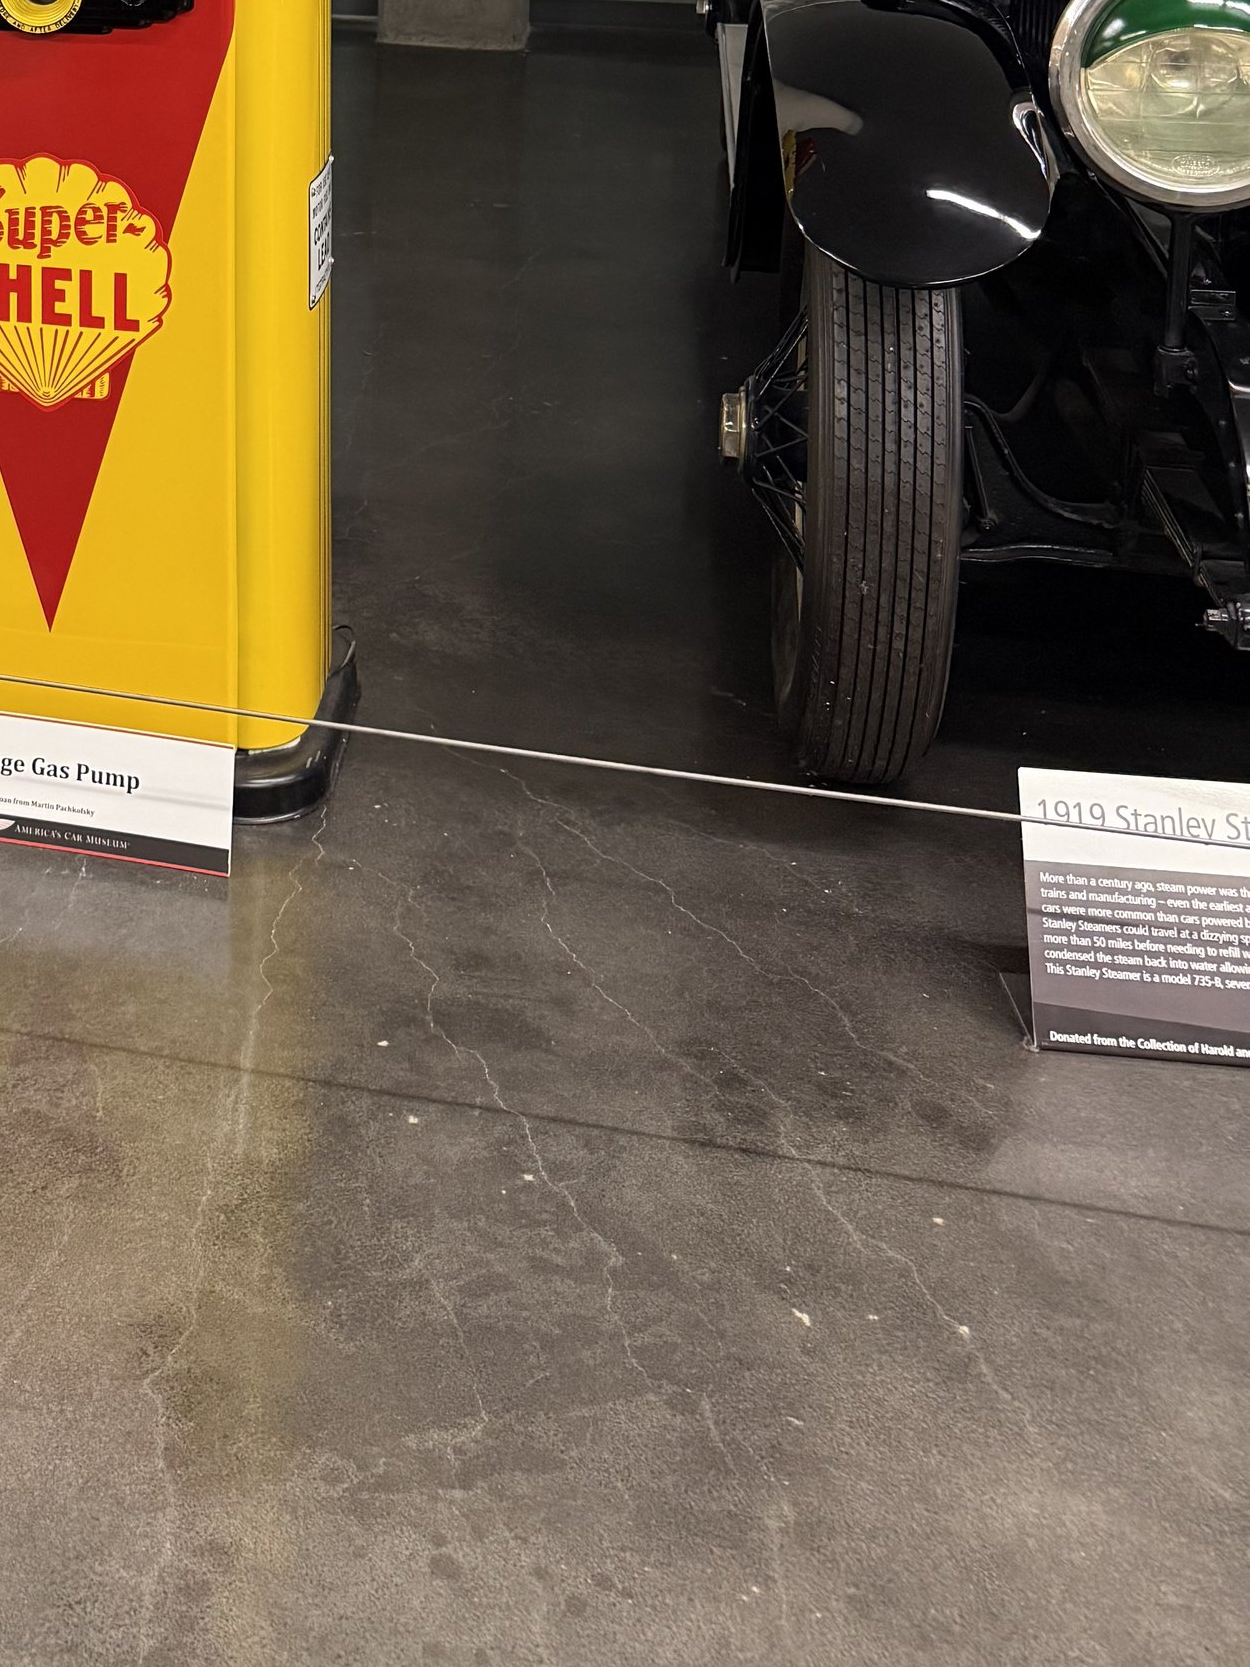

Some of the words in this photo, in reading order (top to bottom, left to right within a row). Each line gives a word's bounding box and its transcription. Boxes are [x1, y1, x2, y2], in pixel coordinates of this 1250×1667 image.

[32, 757, 69, 779] Gas
[76, 763, 139, 794] Pump
[13, 797, 29, 806] from
[31, 800, 54, 809] Martin
[1037, 799, 1106, 826] 1919
[15, 824, 61, 838] AMERICA'S
[64, 832, 82, 842] CAR
[1039, 871, 1064, 884] More
[1066, 873, 1088, 885] than
[1089, 877, 1096, 886] a
[1097, 878, 1132, 891] century
[1134, 881, 1155, 892] ago,
[1156, 882, 1185, 893] steam
[1186, 885, 1217, 896] power
[1218, 888, 1238, 897] was
[1040, 887, 1067, 898] trains
[1068, 889, 1087, 900] and
[1088, 891, 1156, 908] manufacturing
[1166, 898, 1190, 908] even
[1191, 898, 1207, 910] the
[1208, 900, 1244, 912] earliest
[1041, 904, 1061, 913] cars
[1062, 905, 1086, 915] were
[1087, 908, 1113, 918] more
[1113, 909, 1155, 921] common
[1156, 910, 1179, 922] than
[1180, 914, 1200, 924] cars
[1201, 916, 1243, 928] powered
[1042, 917, 1076, 932] Stanley
[1077, 919, 1122, 933] Steamers
[1122, 924, 1149, 936] could
[1150, 926, 1178, 938] travel
[1179, 929, 1190, 939] at
[1191, 931, 1198, 939] a
[1200, 929, 1238, 945] dizzying
[1043, 934, 1068, 944] more
[1069, 933, 1091, 946] than
[1093, 936, 1106, 947] 50
[1107, 937, 1133, 949] miles
[1134, 938, 1165, 952] before
[1166, 943, 1205, 958] needing
[1206, 946, 1217, 956] to
[1218, 946, 1240, 958] refill
[1044, 948, 1094, 961] condensed
[1096, 951, 1112, 963] the
[1113, 954, 1143, 965] steam
[1144, 954, 1167, 968] back
[1168, 957, 1188, 969] into
[1189, 961, 1217, 972] water
[1045, 962, 1064, 974] This
[1065, 964, 1100, 980] Stanley
[1101, 967, 1141, 981] Steamer
[1142, 970, 1151, 982] is
[1152, 973, 1160, 982] a
[1161, 973, 1191, 985] model
[1193, 974, 1224, 989] 735-B,
[1049, 1030, 1092, 1044] Donated
[1092, 1033, 1117, 1046] from
[1118, 1036, 1136, 1048] the
[1137, 1038, 1187, 1052] Collection
[1187, 1042, 1199, 1053] of
[1200, 1043, 1234, 1056] Harold
